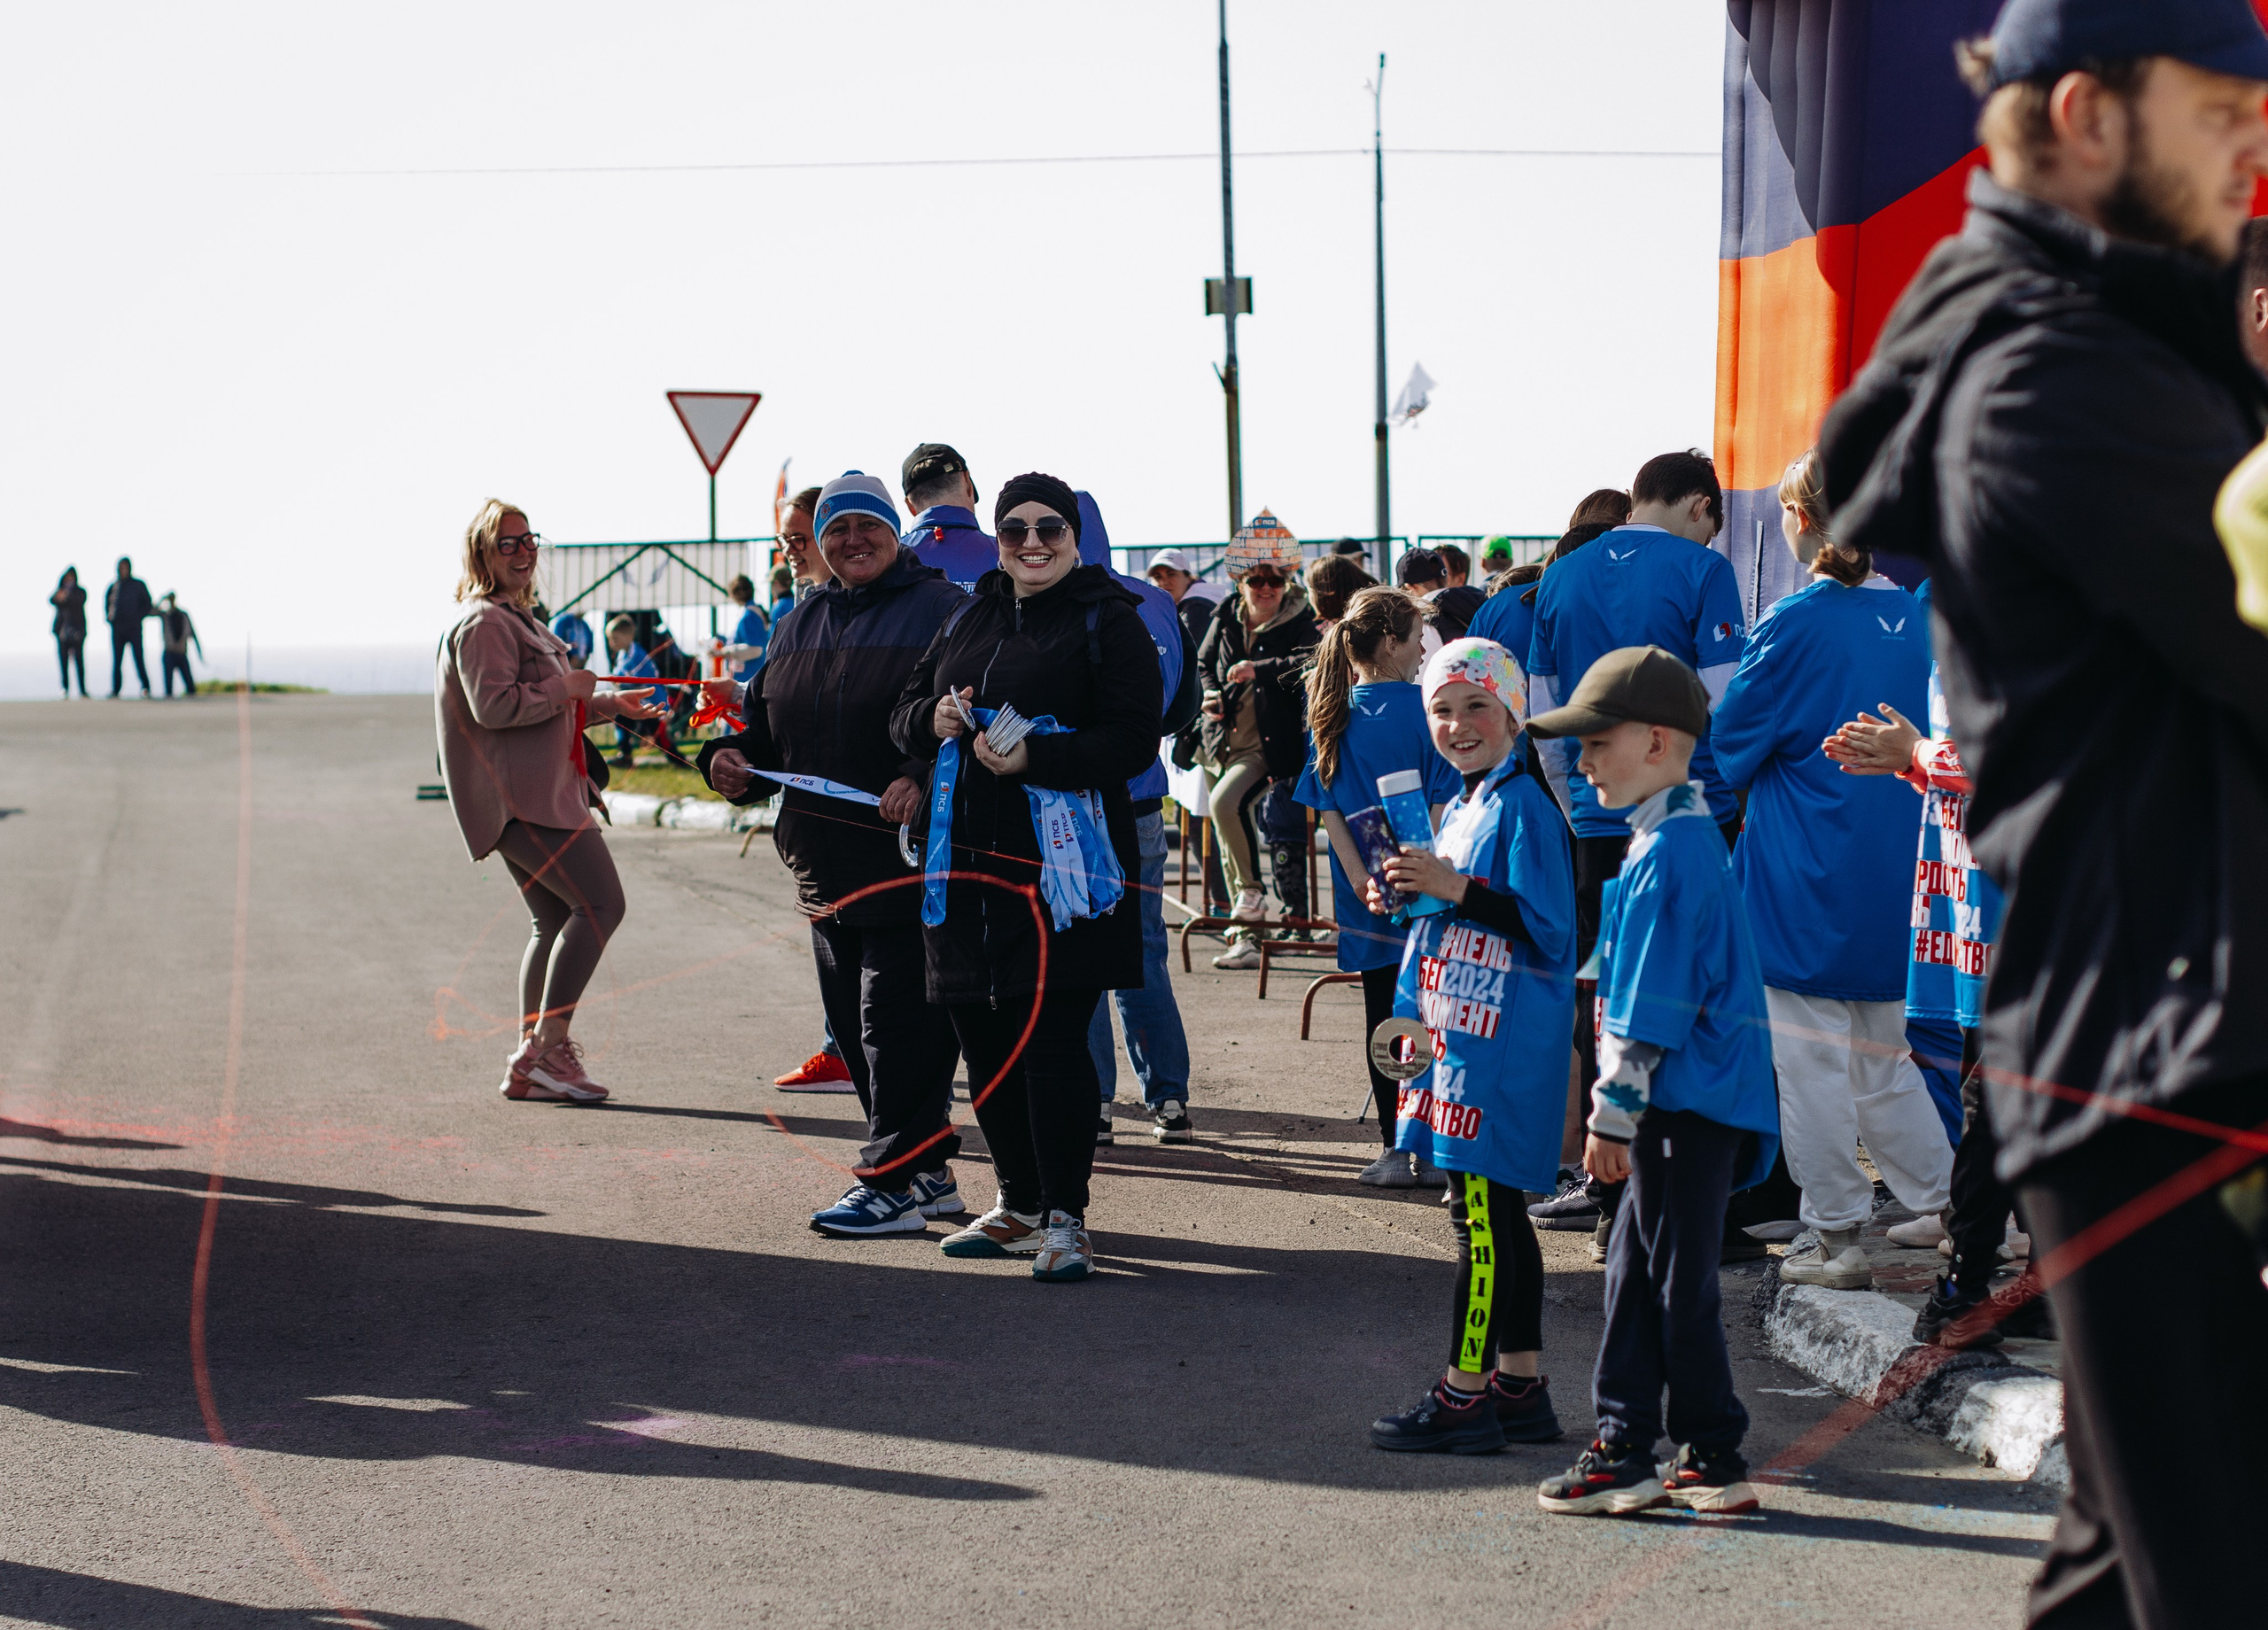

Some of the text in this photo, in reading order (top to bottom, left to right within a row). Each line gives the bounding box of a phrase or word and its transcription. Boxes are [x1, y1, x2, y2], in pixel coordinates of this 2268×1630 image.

[799, 778, 815, 787] ПСБ
[936, 793, 948, 812] ПСБ
[1052, 819, 1061, 838] ПСБ
[1438, 925, 1512, 974] #ЦЕЛЬ
